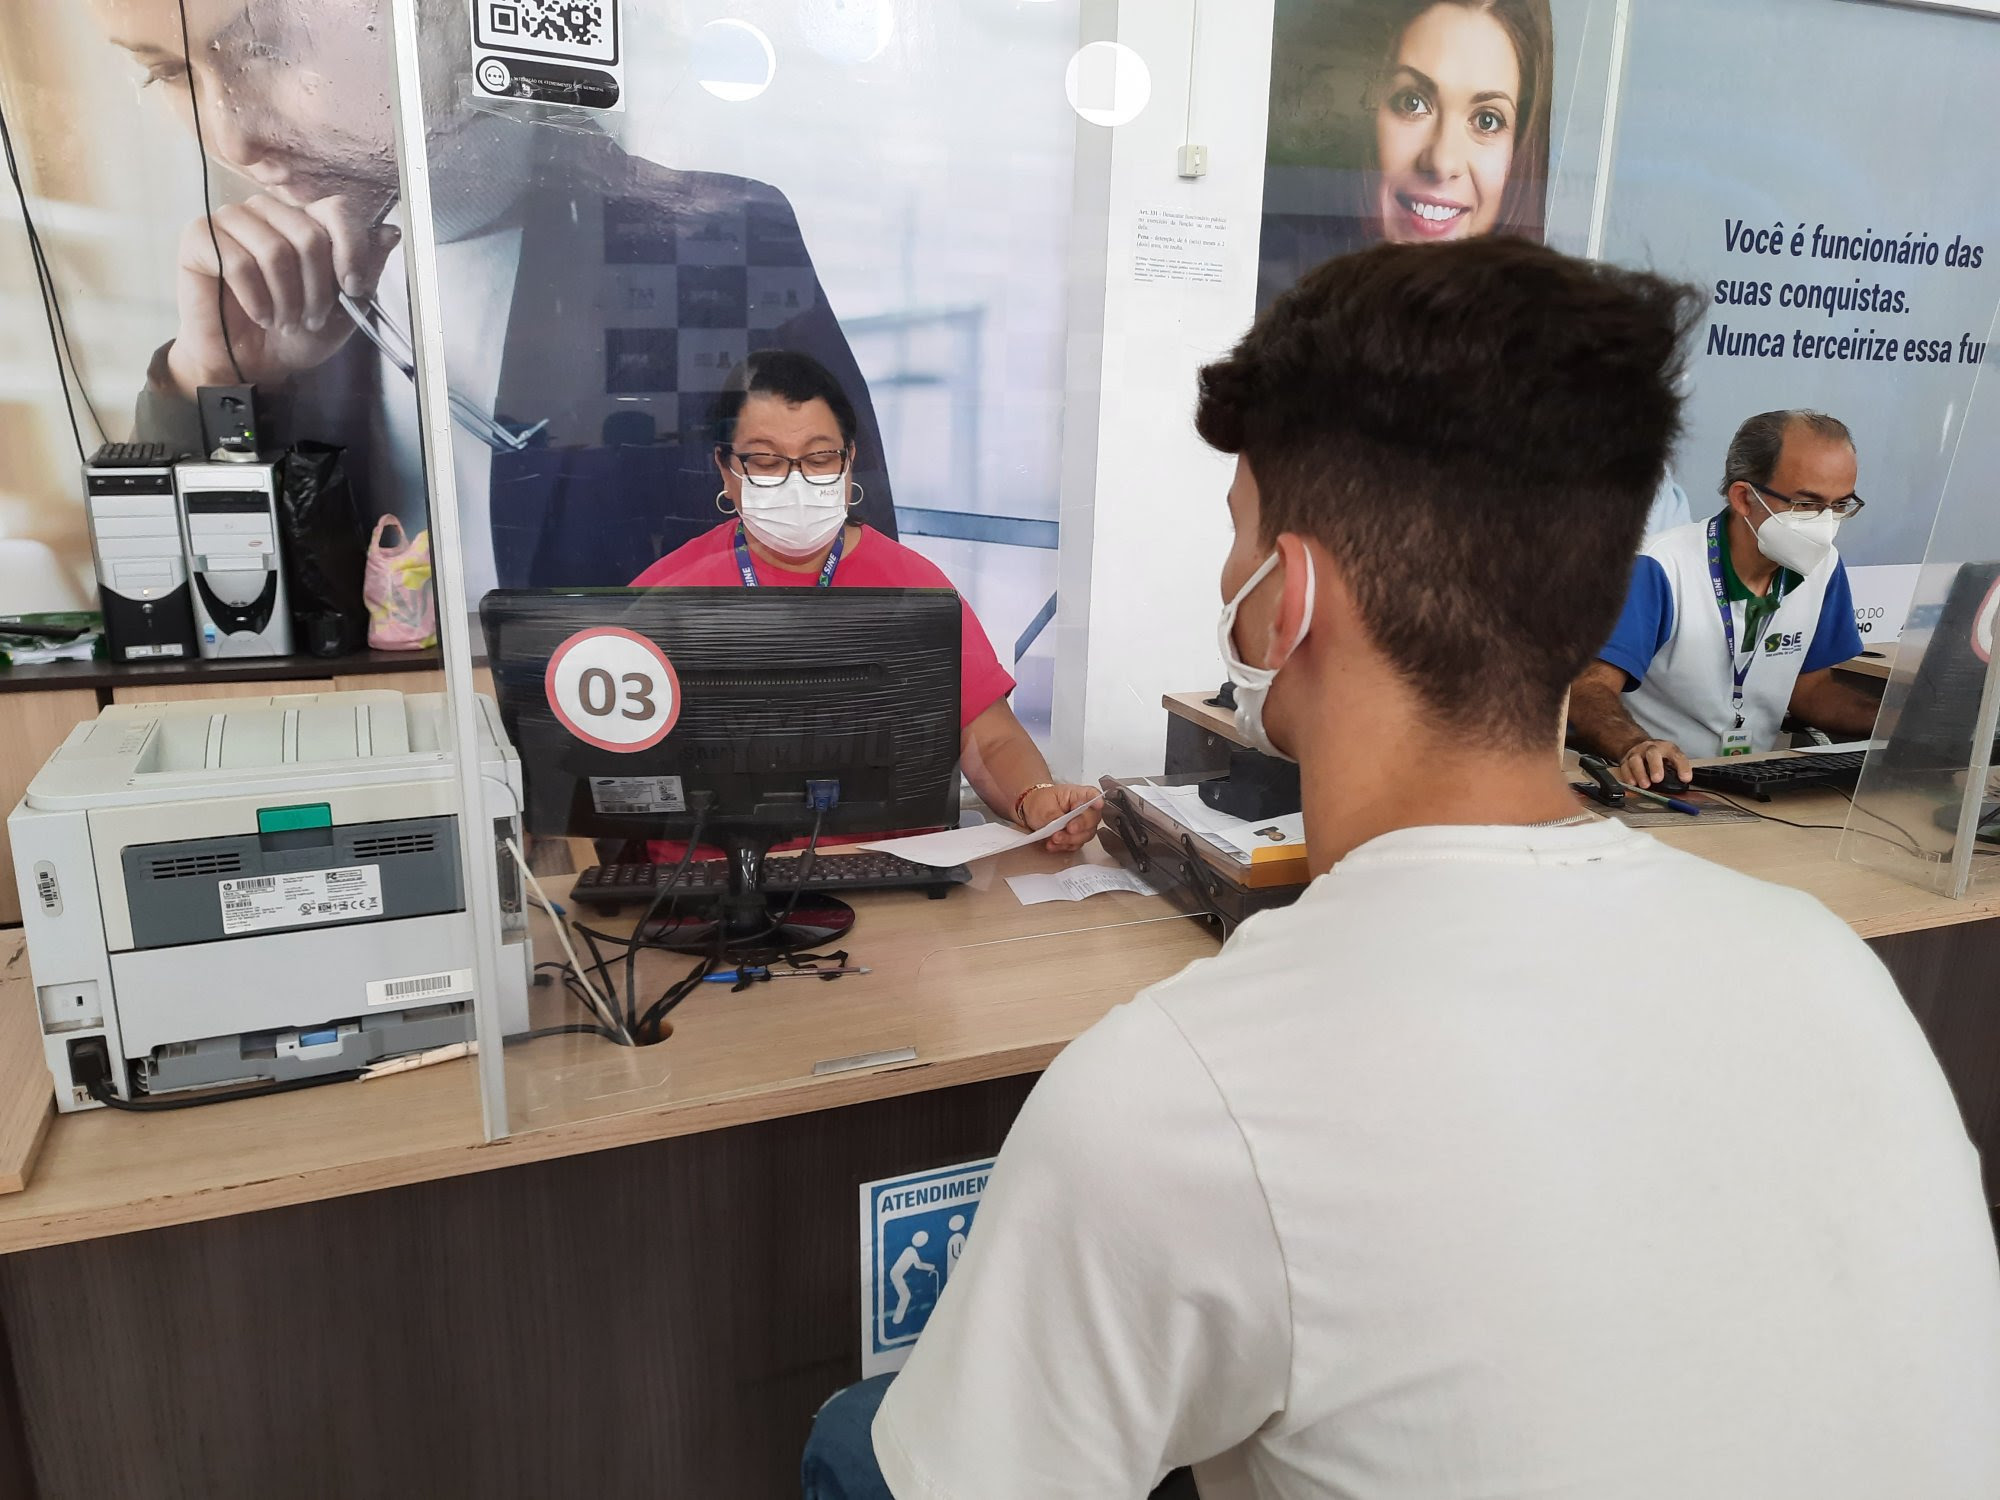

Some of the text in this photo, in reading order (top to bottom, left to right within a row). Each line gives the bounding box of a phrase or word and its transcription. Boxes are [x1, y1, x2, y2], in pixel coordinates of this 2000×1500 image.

[1725, 219, 1984, 269] Você é funcionário das
[1714, 278, 1910, 318] suas conquistas.
[1706, 324, 1785, 357] Nunca
[1792, 328, 1899, 361] terceirize
[1903, 337, 1952, 363] essa
[1868, 607, 1884, 618] DO
[578, 667, 656, 721] 03
[881, 1175, 988, 1213] ATENDIMEN
